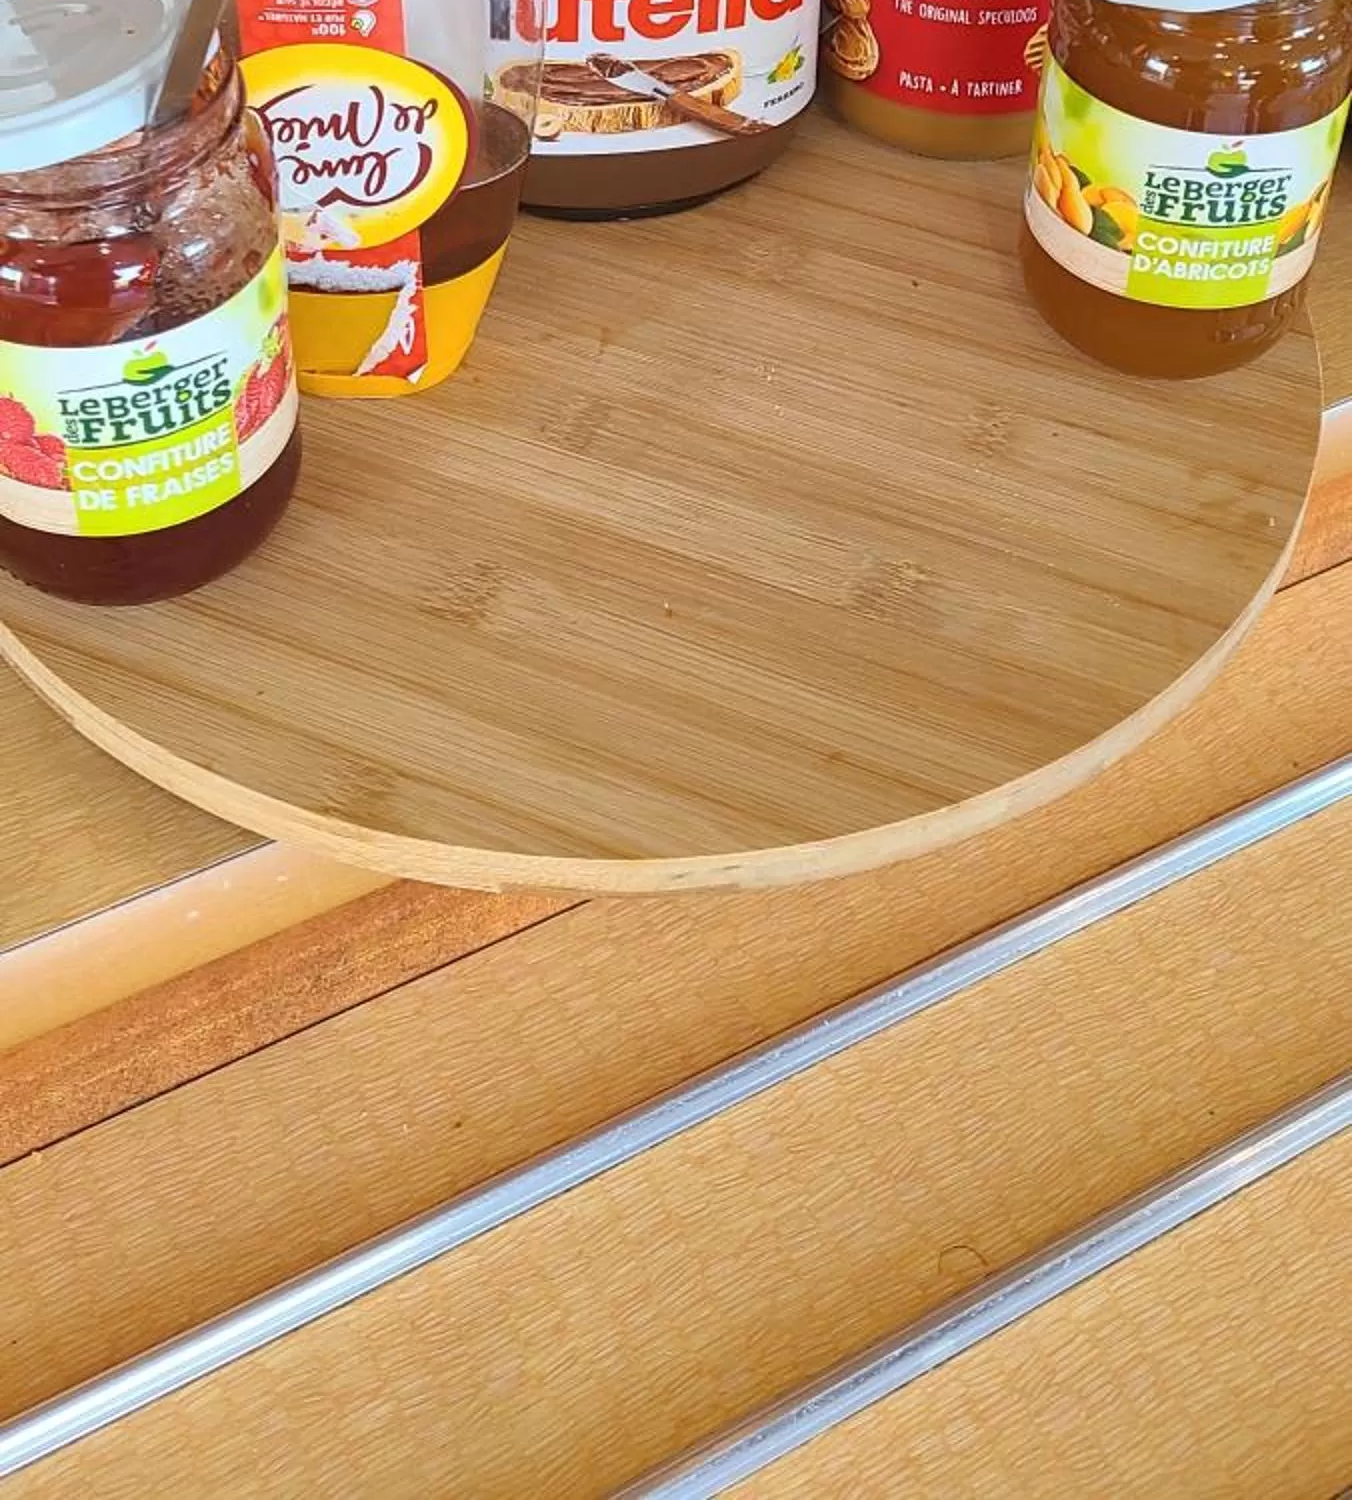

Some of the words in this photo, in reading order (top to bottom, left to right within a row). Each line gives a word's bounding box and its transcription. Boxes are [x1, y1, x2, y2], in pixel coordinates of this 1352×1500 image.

[919, 3, 972, 25] ORIGINAL
[978, 6, 1038, 25] SPECULOOS
[899, 70, 934, 94] PASTA
[967, 77, 1024, 97] TARTINER
[390, 97, 439, 135] de
[1155, 191, 1288, 225] Fruits
[1136, 231, 1277, 260] CONFITURE
[1133, 254, 1271, 282] D'ABRICOTS
[79, 378, 232, 444] Fruits
[73, 422, 232, 482] CONFITURE
[78, 489, 118, 511] DE
[126, 451, 236, 508] FRAISES
